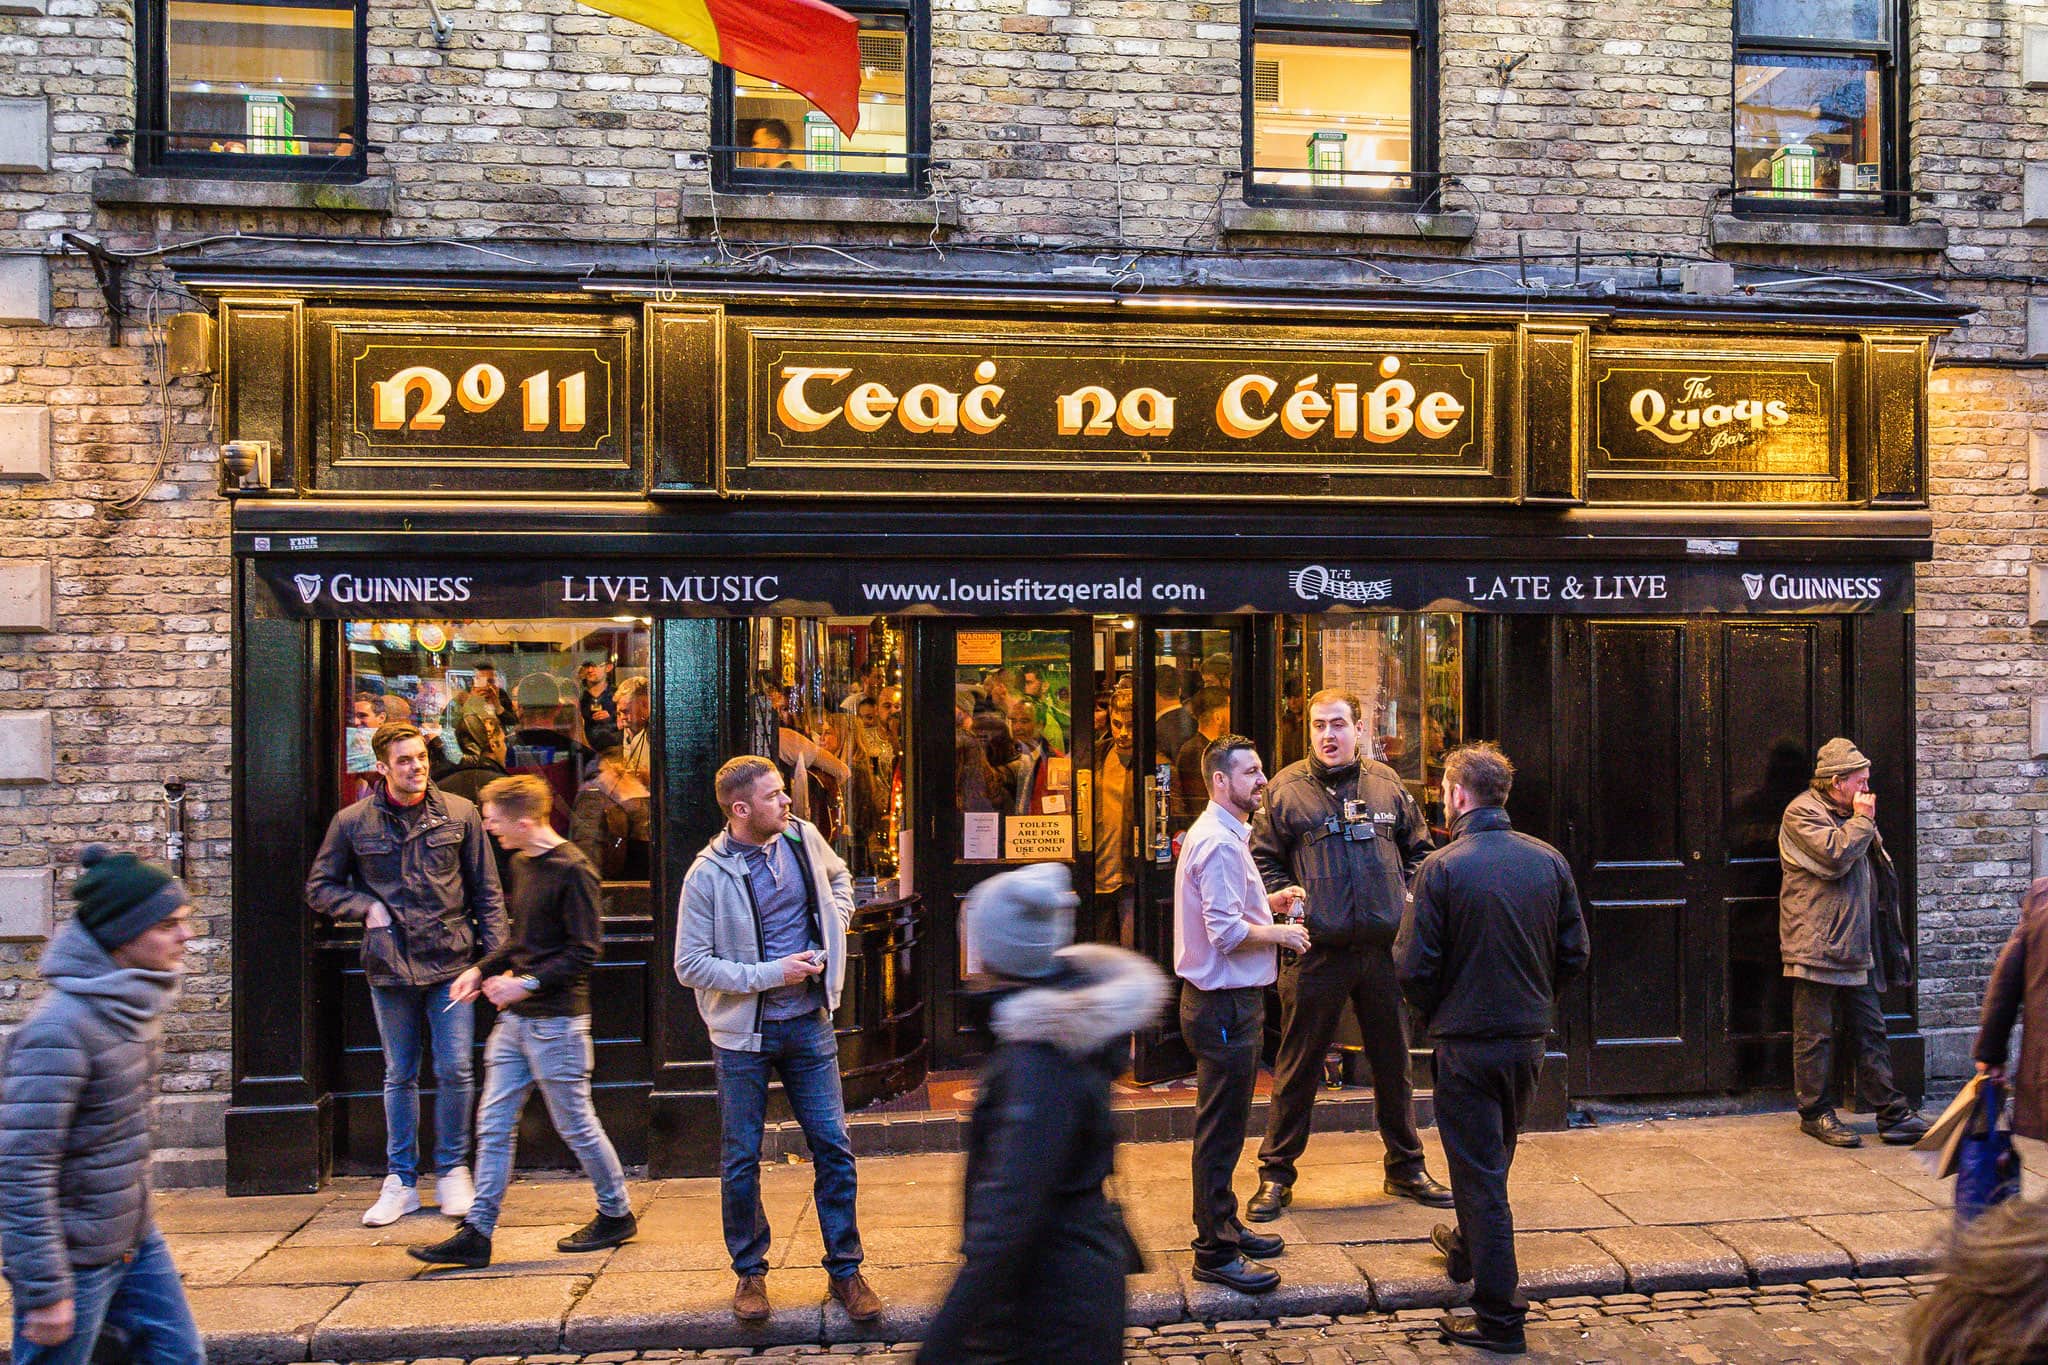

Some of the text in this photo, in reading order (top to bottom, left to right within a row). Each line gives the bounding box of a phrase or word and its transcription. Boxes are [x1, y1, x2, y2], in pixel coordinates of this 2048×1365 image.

[1677, 376, 1716, 403] The
[1056, 385, 1178, 436] na
[1630, 388, 1790, 444] Quays
[1703, 430, 1749, 455] Bar
[330, 573, 471, 603] GUINNESS
[561, 575, 779, 602] LIVE MUSIC
[861, 577, 1206, 604] www.louisfitzgeraldcom
[1466, 575, 1668, 601] LATE & LIVE
[1769, 573, 1881, 600] GUINNESS
[1019, 821, 1059, 829] TOILETS
